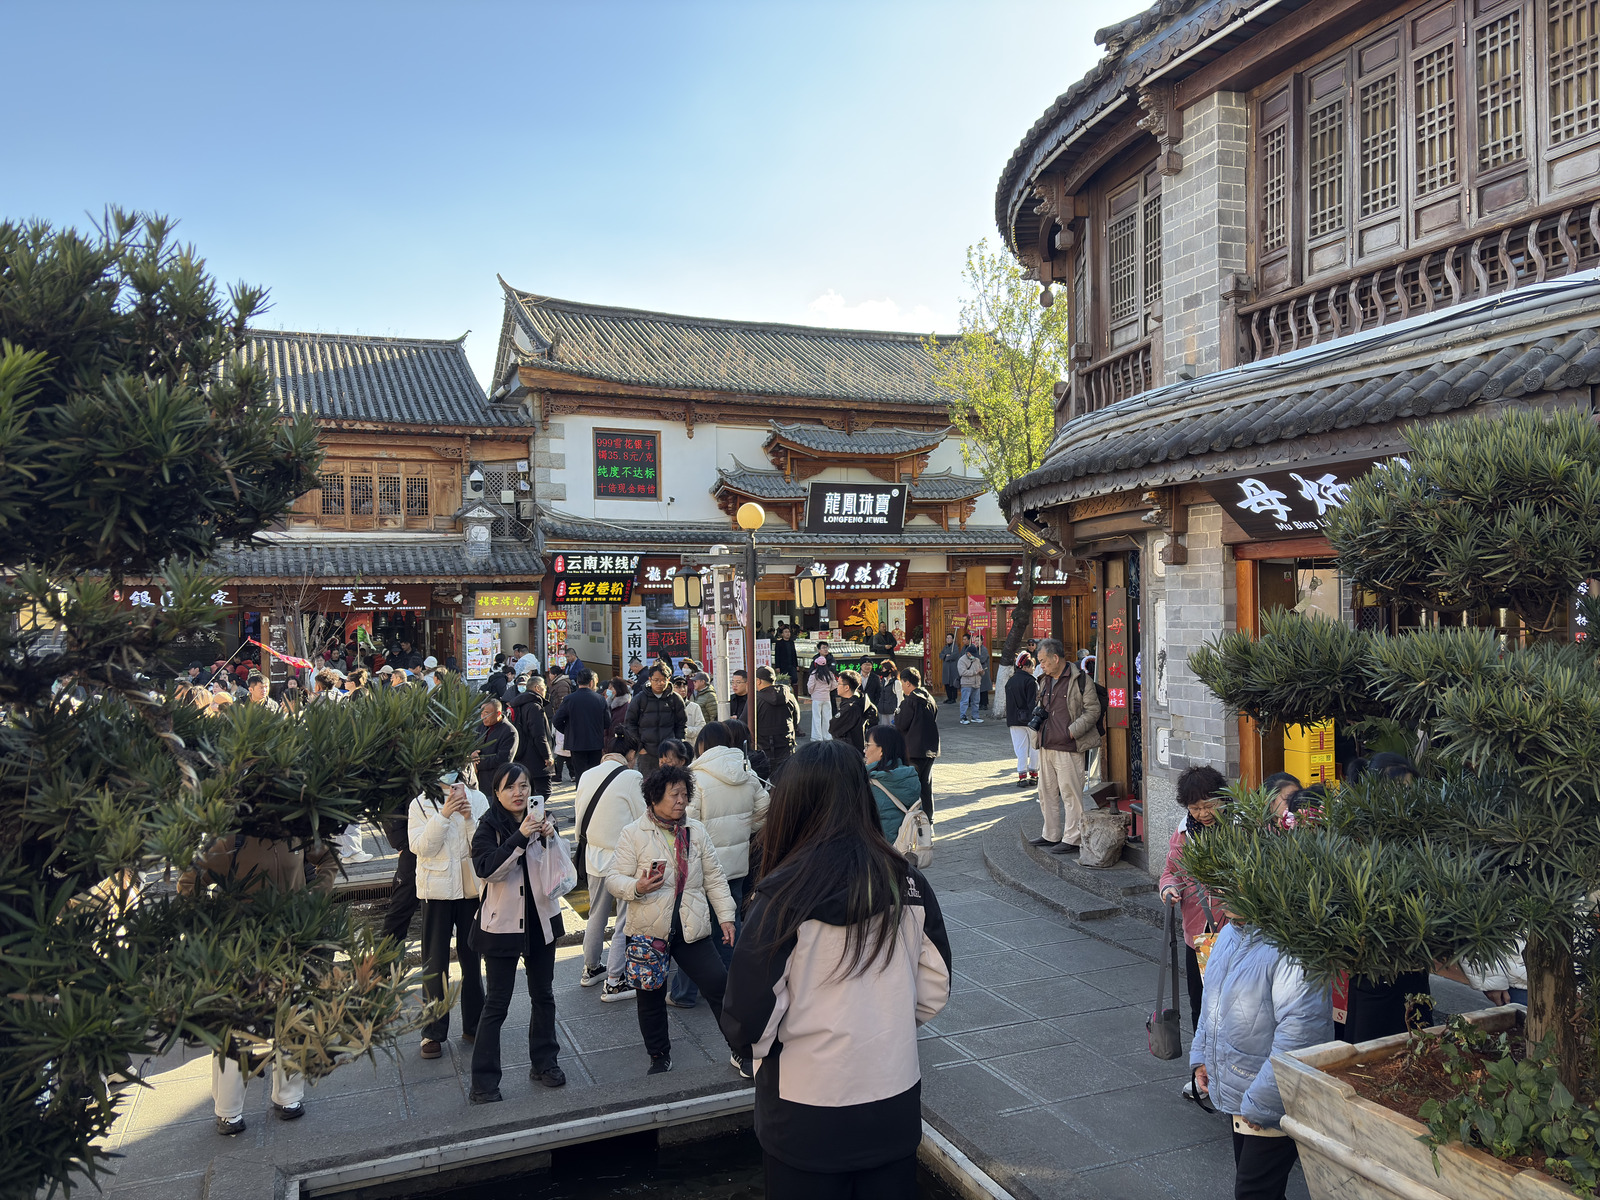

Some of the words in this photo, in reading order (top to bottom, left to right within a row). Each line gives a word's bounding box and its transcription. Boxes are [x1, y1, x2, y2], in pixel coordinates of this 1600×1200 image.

[597, 438, 653, 450] 999雪花银手
[597, 465, 656, 479] 纯度不达标
[598, 483, 656, 494] 十倍现金赔偿
[1275, 522, 1293, 532] Mu
[1295, 519, 1316, 531] Bing
[567, 555, 629, 570] 云南米线
[568, 581, 624, 596] 云龙卷粉
[340, 590, 401, 606] 李文彬
[646, 631, 688, 646] 雪花银
[1107, 617, 1126, 679] 母炳林
